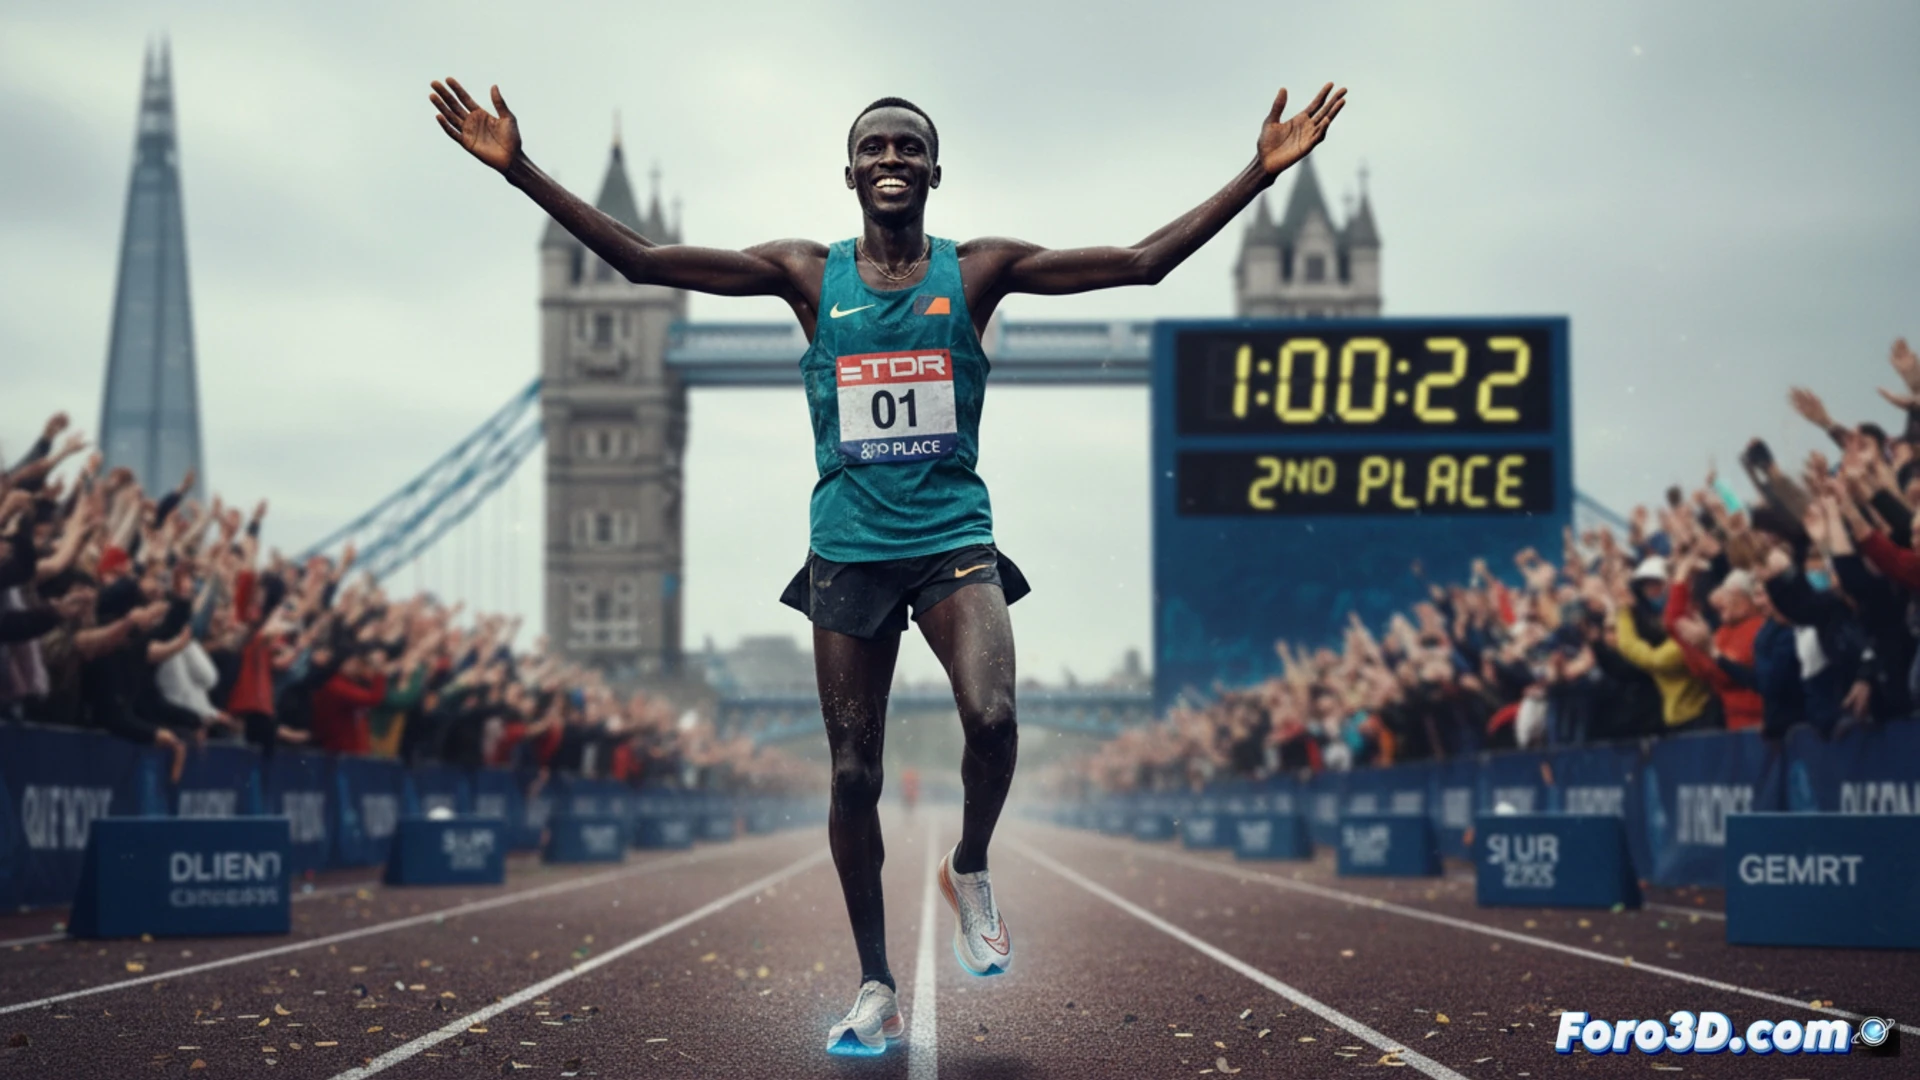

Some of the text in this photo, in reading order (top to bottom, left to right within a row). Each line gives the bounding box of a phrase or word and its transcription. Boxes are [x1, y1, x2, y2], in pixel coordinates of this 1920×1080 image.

[1233, 337, 1530, 423] 1:00:22
[871, 389, 917, 429] 01
[893, 440, 940, 456] PLACE
[1249, 456, 1524, 508] 2ND PLACE
[1739, 854, 1863, 886] GEMRT
